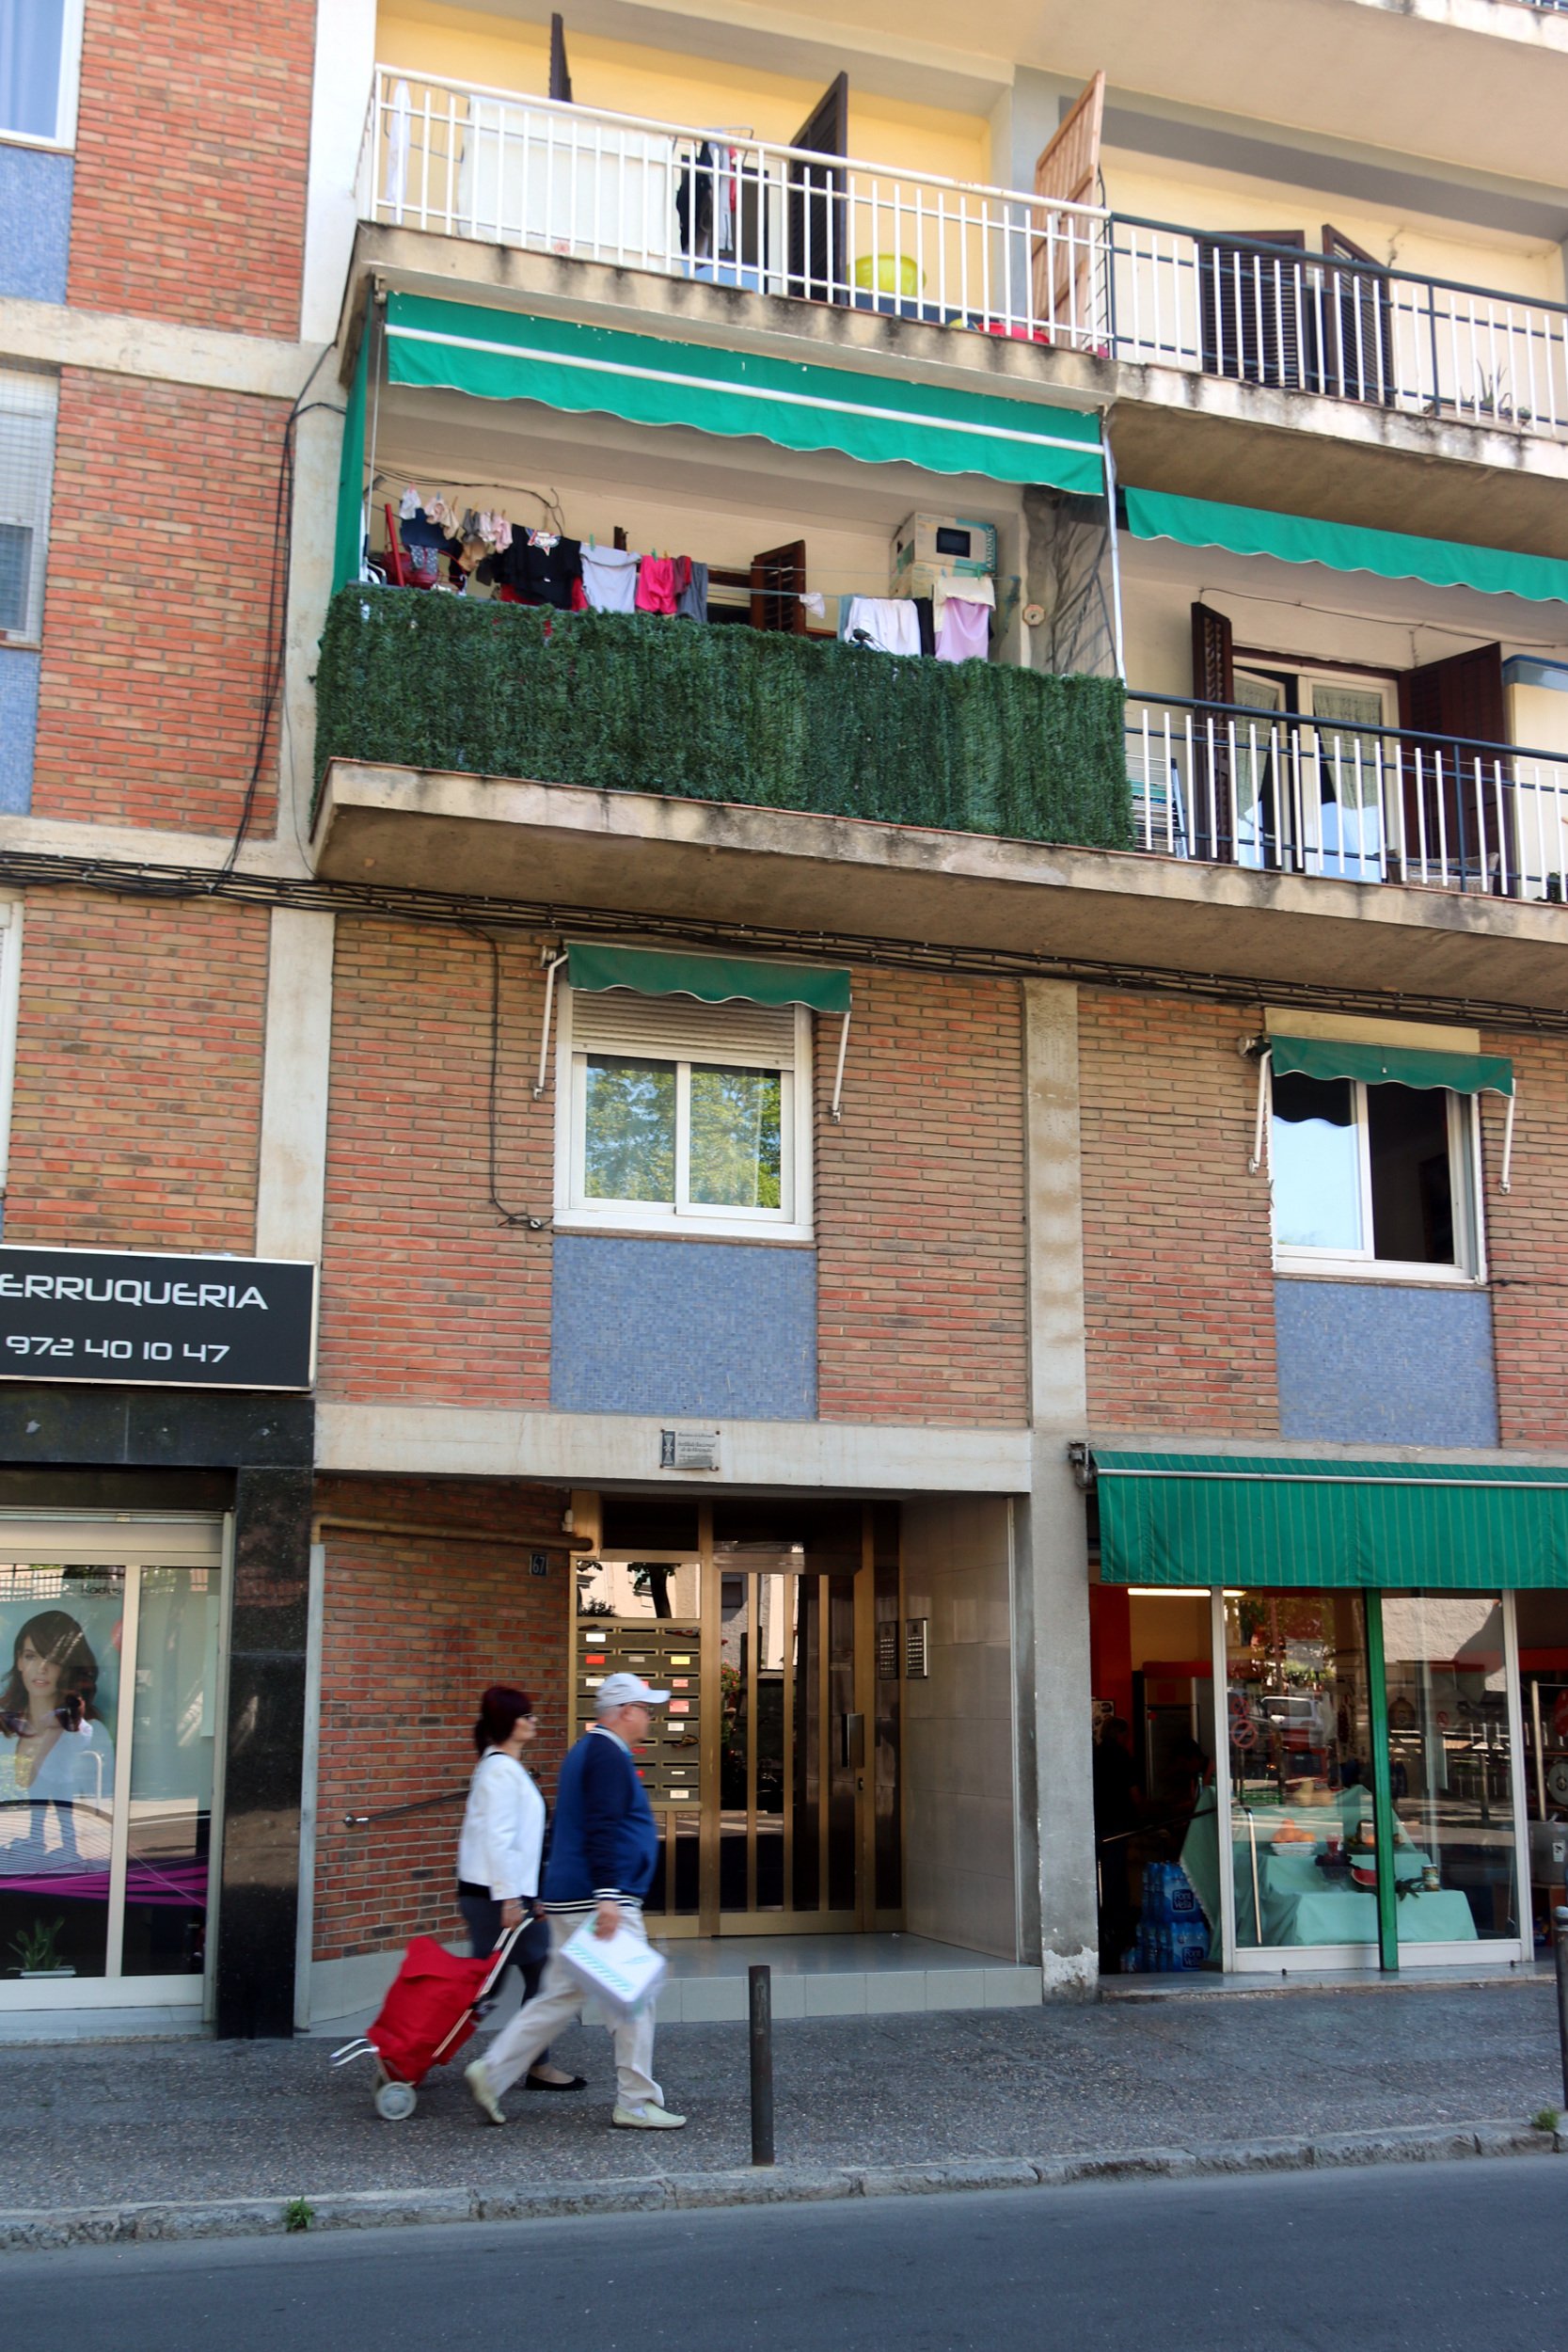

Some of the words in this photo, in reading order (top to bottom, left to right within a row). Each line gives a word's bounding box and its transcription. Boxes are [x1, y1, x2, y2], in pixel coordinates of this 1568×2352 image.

[6, 1335, 74, 1357] 972
[85, 1339, 133, 1359] 40
[143, 1341, 173, 1361] 10
[182, 1343, 230, 1363] 47
[533, 1555, 546, 1574] 67
[1174, 1890, 1192, 1900] Font
